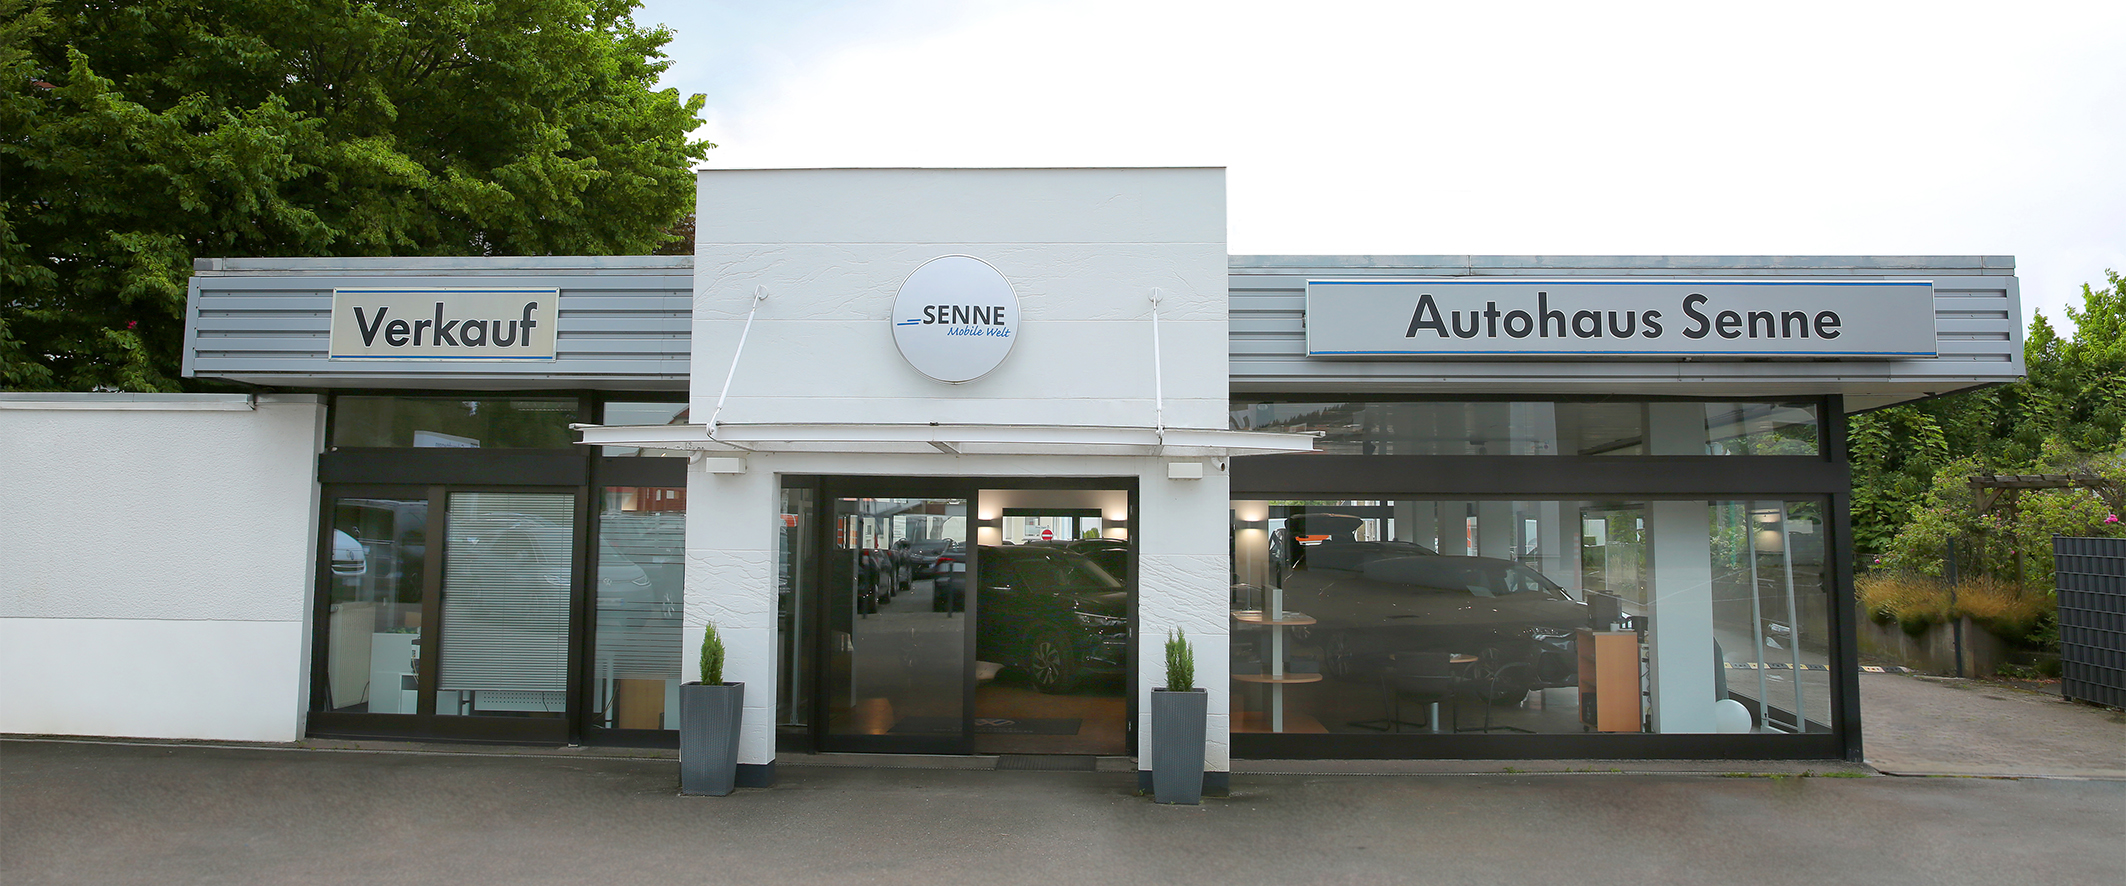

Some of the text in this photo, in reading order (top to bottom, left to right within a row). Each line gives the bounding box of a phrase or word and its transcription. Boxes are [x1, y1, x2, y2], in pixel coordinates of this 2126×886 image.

[352, 301, 538, 348] Verkauf
[922, 304, 1005, 326] SENNE
[947, 325, 1011, 338] Mobile Welt
[1405, 291, 1842, 340] Autohaus Senne
